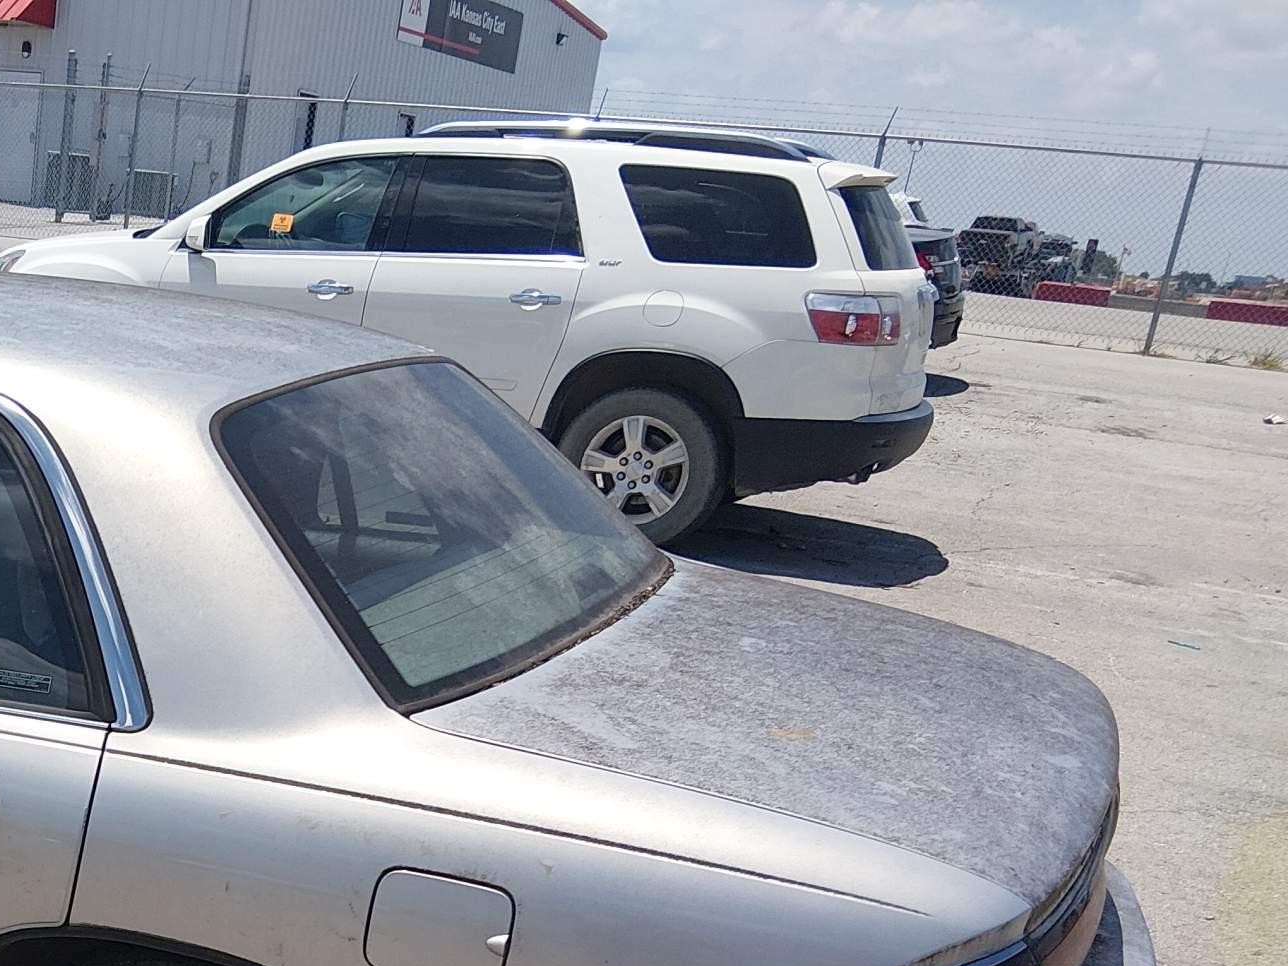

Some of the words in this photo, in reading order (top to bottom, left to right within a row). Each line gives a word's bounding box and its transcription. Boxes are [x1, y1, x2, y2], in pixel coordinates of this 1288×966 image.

[461, 3, 482, 27] Kansas
[482, 11, 494, 35] City
[493, 15, 506, 35] East
